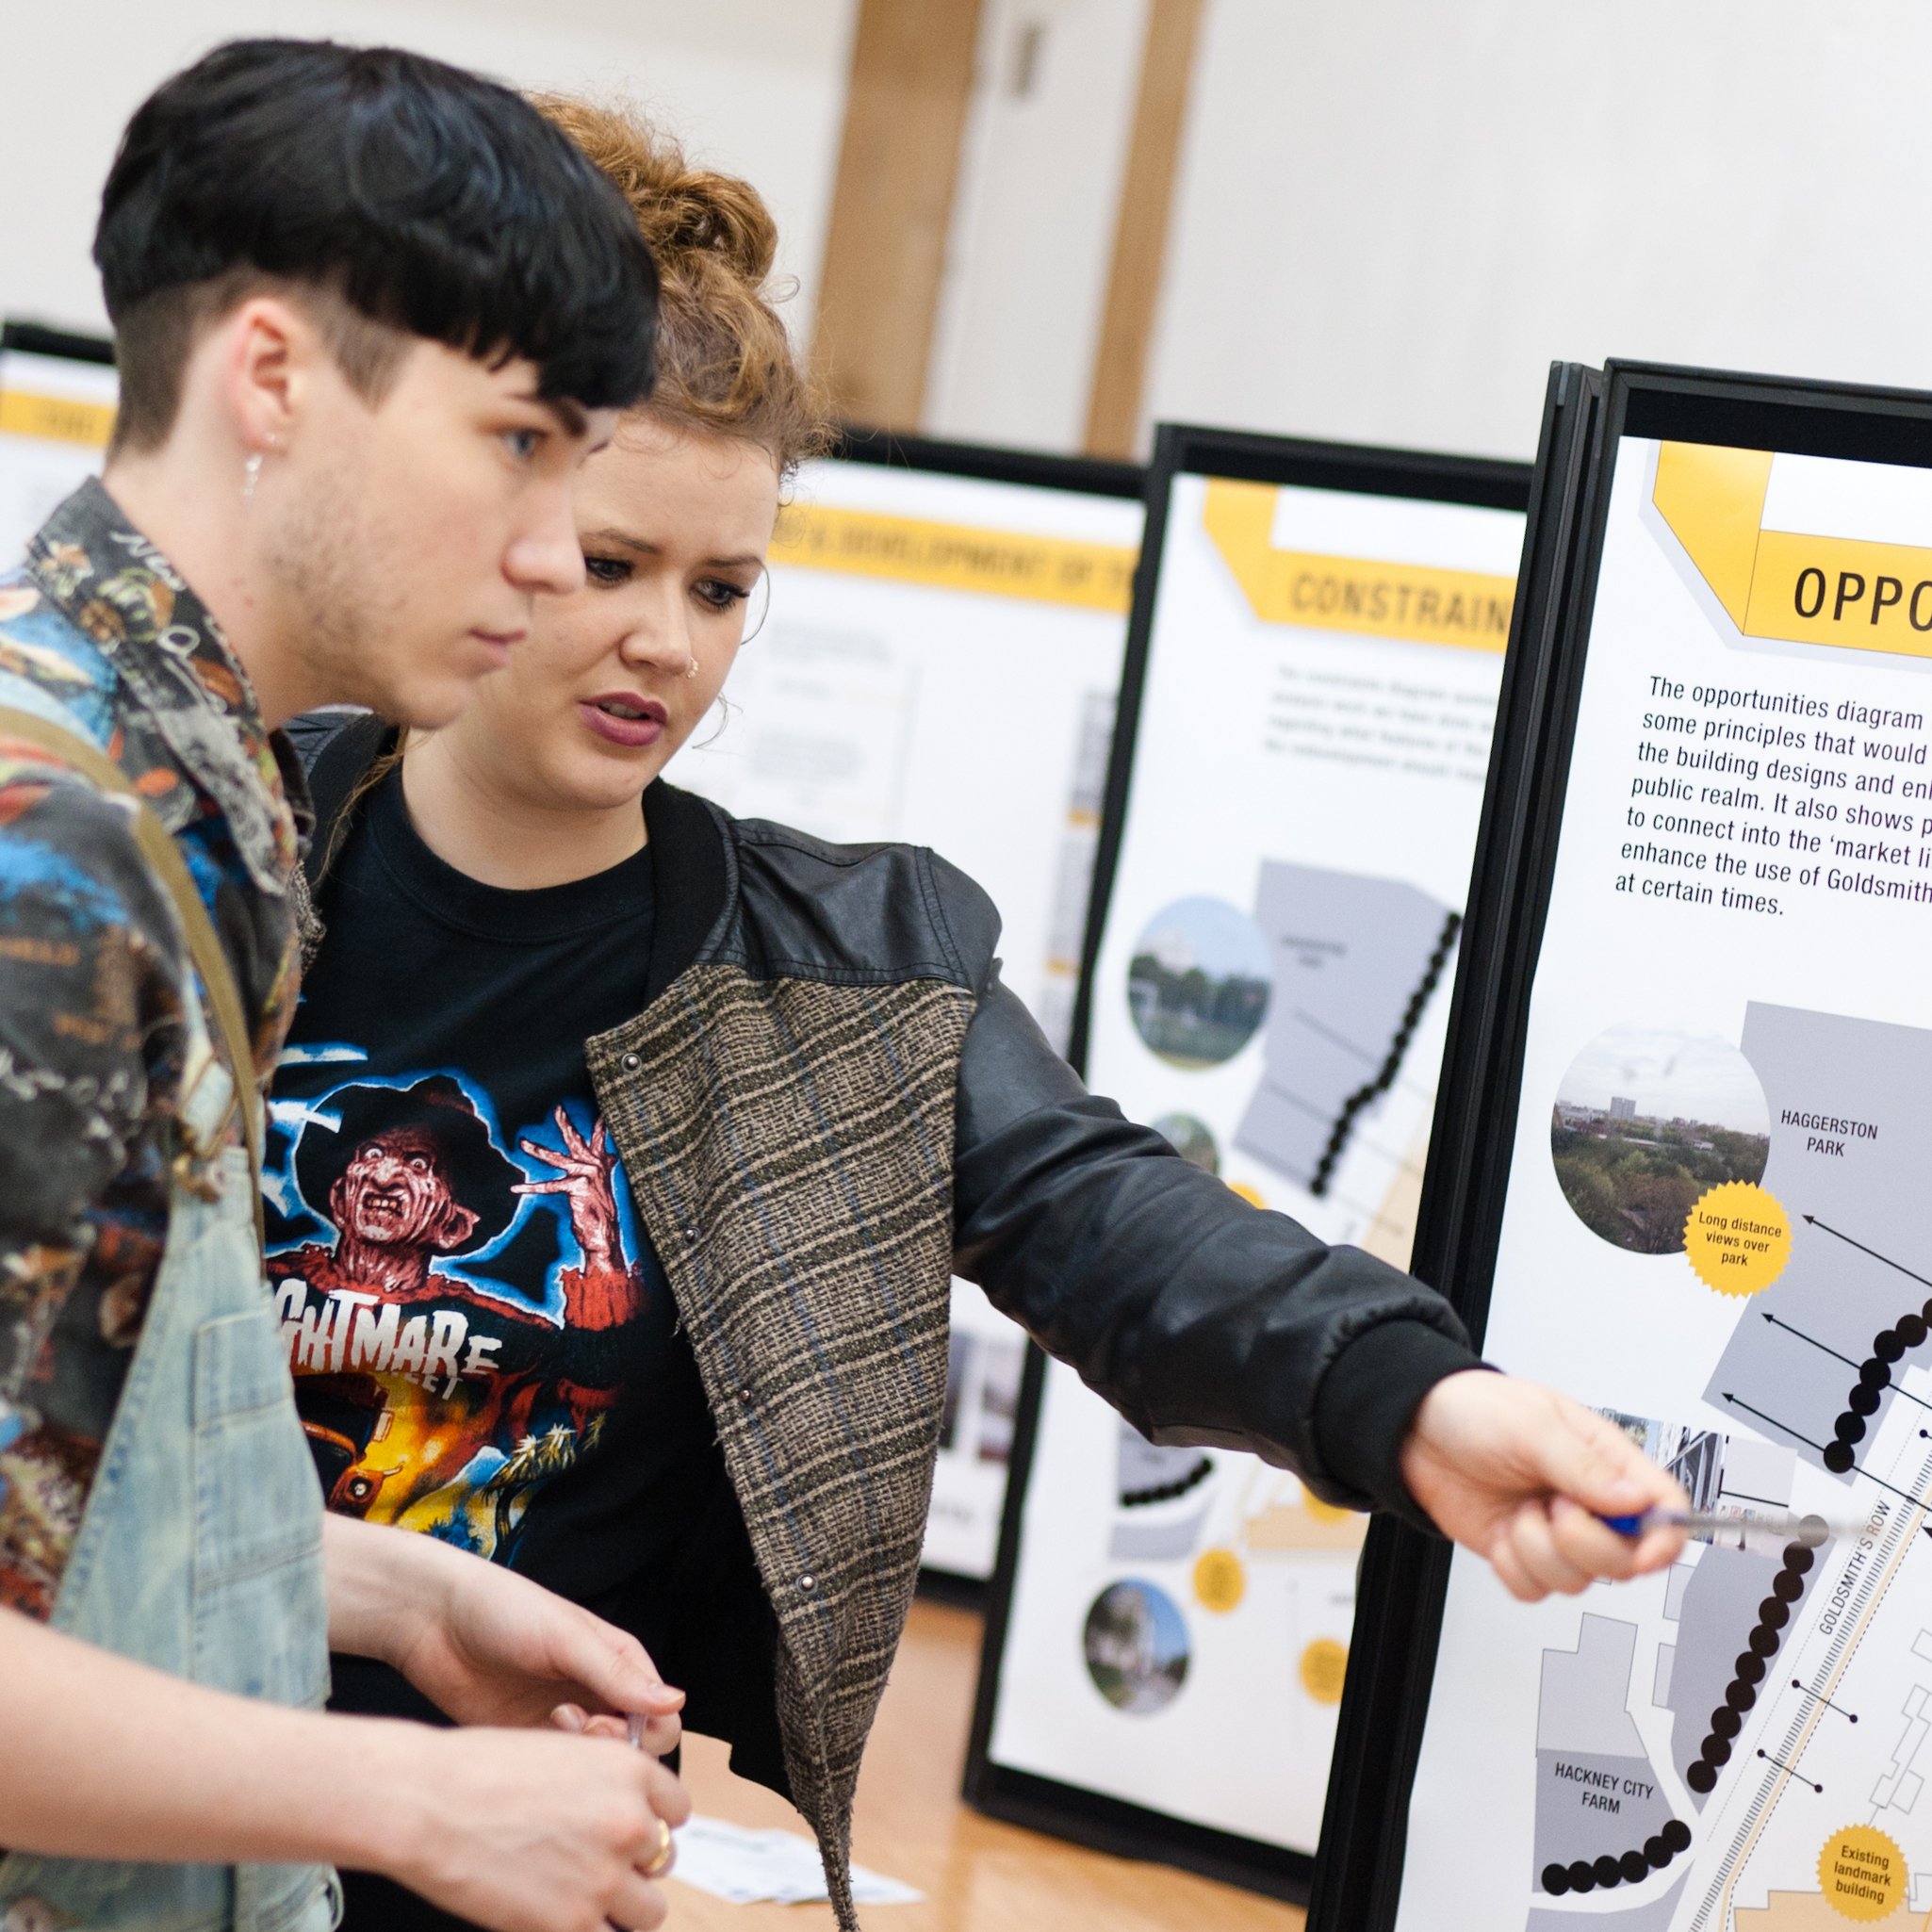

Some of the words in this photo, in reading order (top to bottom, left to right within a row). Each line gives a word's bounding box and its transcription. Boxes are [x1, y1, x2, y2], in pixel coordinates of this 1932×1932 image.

[1793, 567, 1932, 632] OPPO
[1650, 676, 1684, 700] The
[1693, 685, 1829, 719] opportunities
[1837, 700, 1924, 730] diagram
[1643, 712, 1696, 734] some
[1704, 719, 1807, 750] principles
[1814, 731, 1856, 756] that
[1863, 741, 1927, 764] would
[1638, 741, 1669, 763] the
[1677, 746, 1759, 781] building
[1766, 760, 1847, 790] designs
[1855, 775, 1894, 794] and
[1631, 777, 1694, 798] public
[1701, 786, 1764, 811] realm.
[1774, 794, 1787, 814] It
[1794, 797, 1838, 821] also
[1845, 805, 1913, 832] shows
[1627, 807, 1645, 828] to
[1653, 811, 1735, 841] connect
[1742, 822, 1780, 847] into
[1789, 829, 1821, 853] the
[1621, 842, 1707, 870] enhance
[1715, 853, 1747, 876] the
[1755, 861, 1792, 882] use
[1799, 867, 1820, 887] of
[1827, 868, 1932, 904] Goldsmith
[1615, 873, 1635, 892] at
[1642, 878, 1713, 905] certain
[1721, 886, 1784, 915] times.
[1781, 1109, 1878, 1139] HAGGERSTON
[1807, 1137, 1845, 1157] PARK
[1698, 1211, 1727, 1230] Long
[1731, 1219, 1782, 1238] distance
[1706, 1230, 1740, 1248] views
[1744, 1237, 1770, 1253] over
[1721, 1252, 1748, 1267] park
[1820, 1537, 1874, 1636] GOLDSMITH'S
[1867, 1500, 1891, 1536] ROW
[1555, 1761, 1619, 1792] HACKNEY
[1623, 1780, 1655, 1800] CITY
[1581, 1792, 1620, 1814] FARM
[1834, 1861, 1891, 1886] landmark
[1841, 1844, 1890, 1871] Existing
[1835, 1879, 1885, 1905] building
